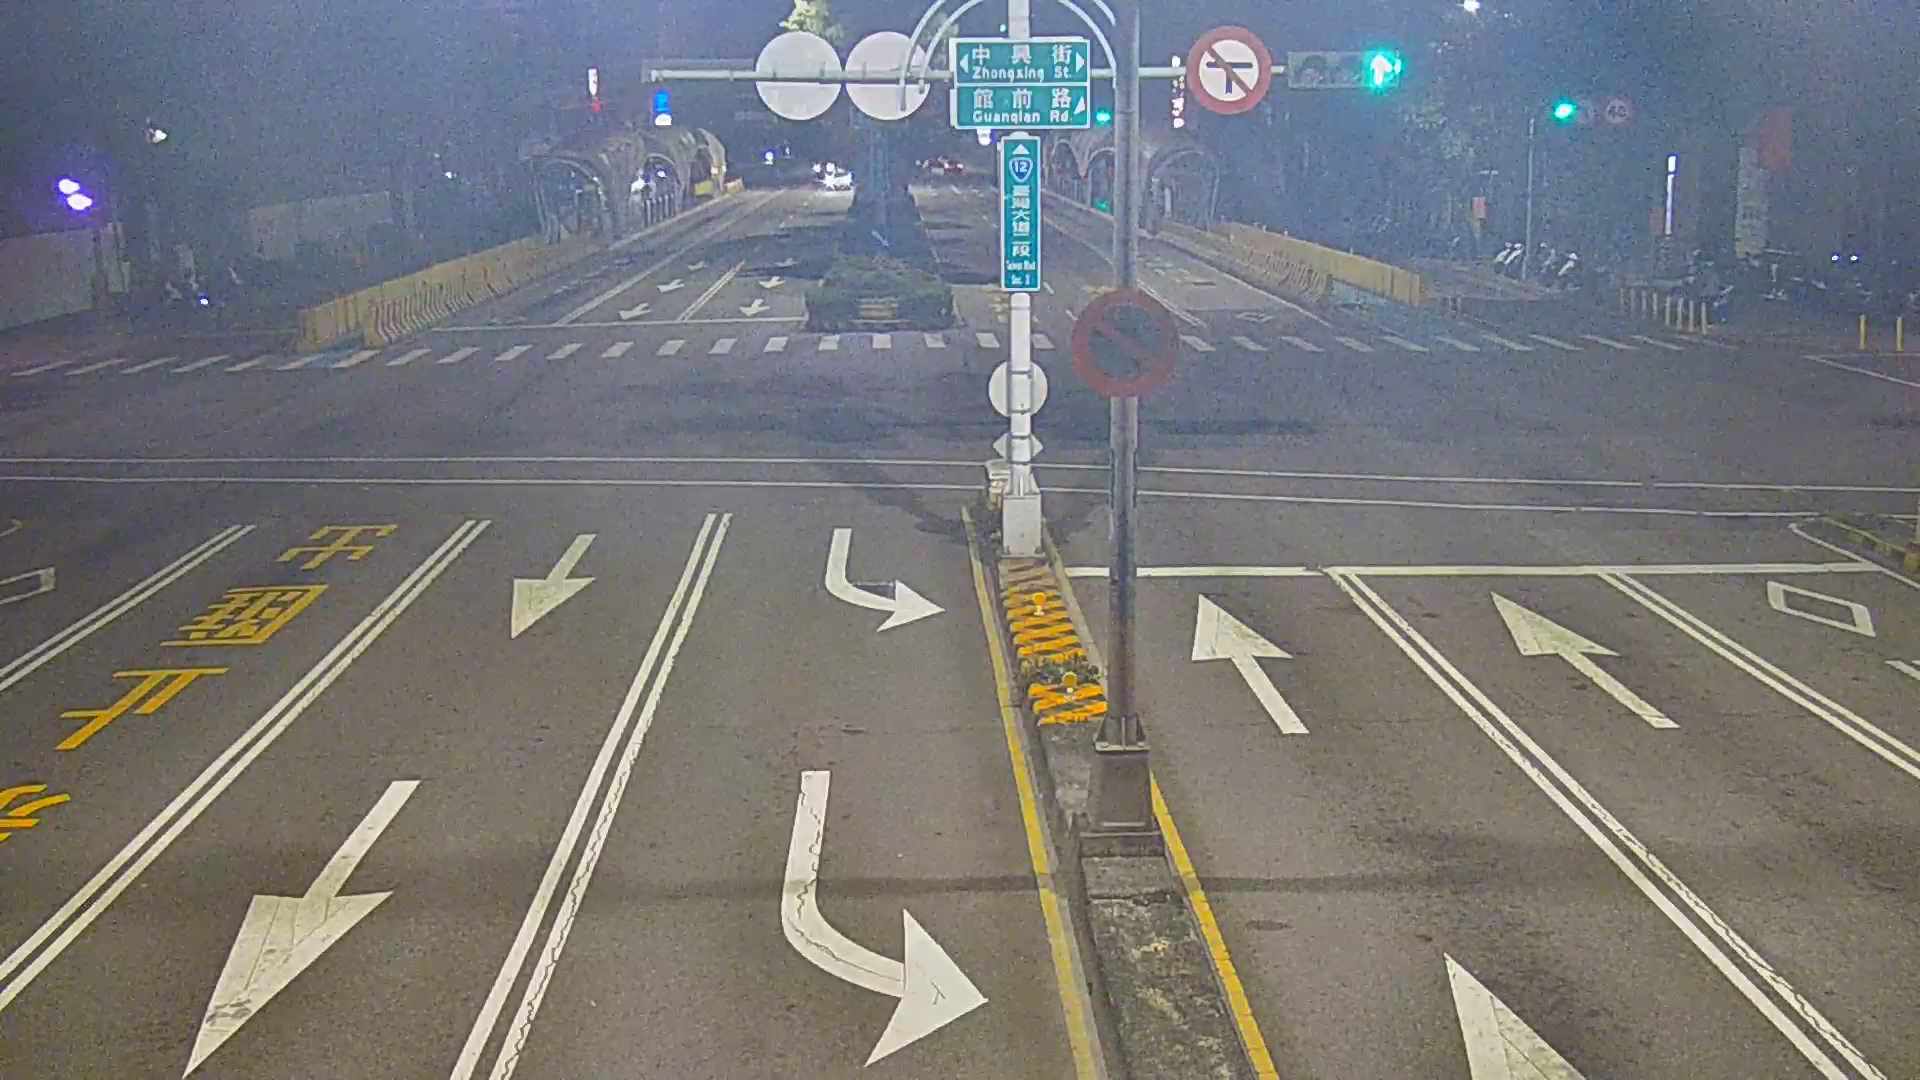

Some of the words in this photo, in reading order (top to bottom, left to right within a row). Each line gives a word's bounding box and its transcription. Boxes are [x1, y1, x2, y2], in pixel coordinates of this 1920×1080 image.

[972, 66, 1044, 82] Zhongxing
[973, 111, 1040, 123] Guanqian
[1012, 160, 1028, 173] 12
